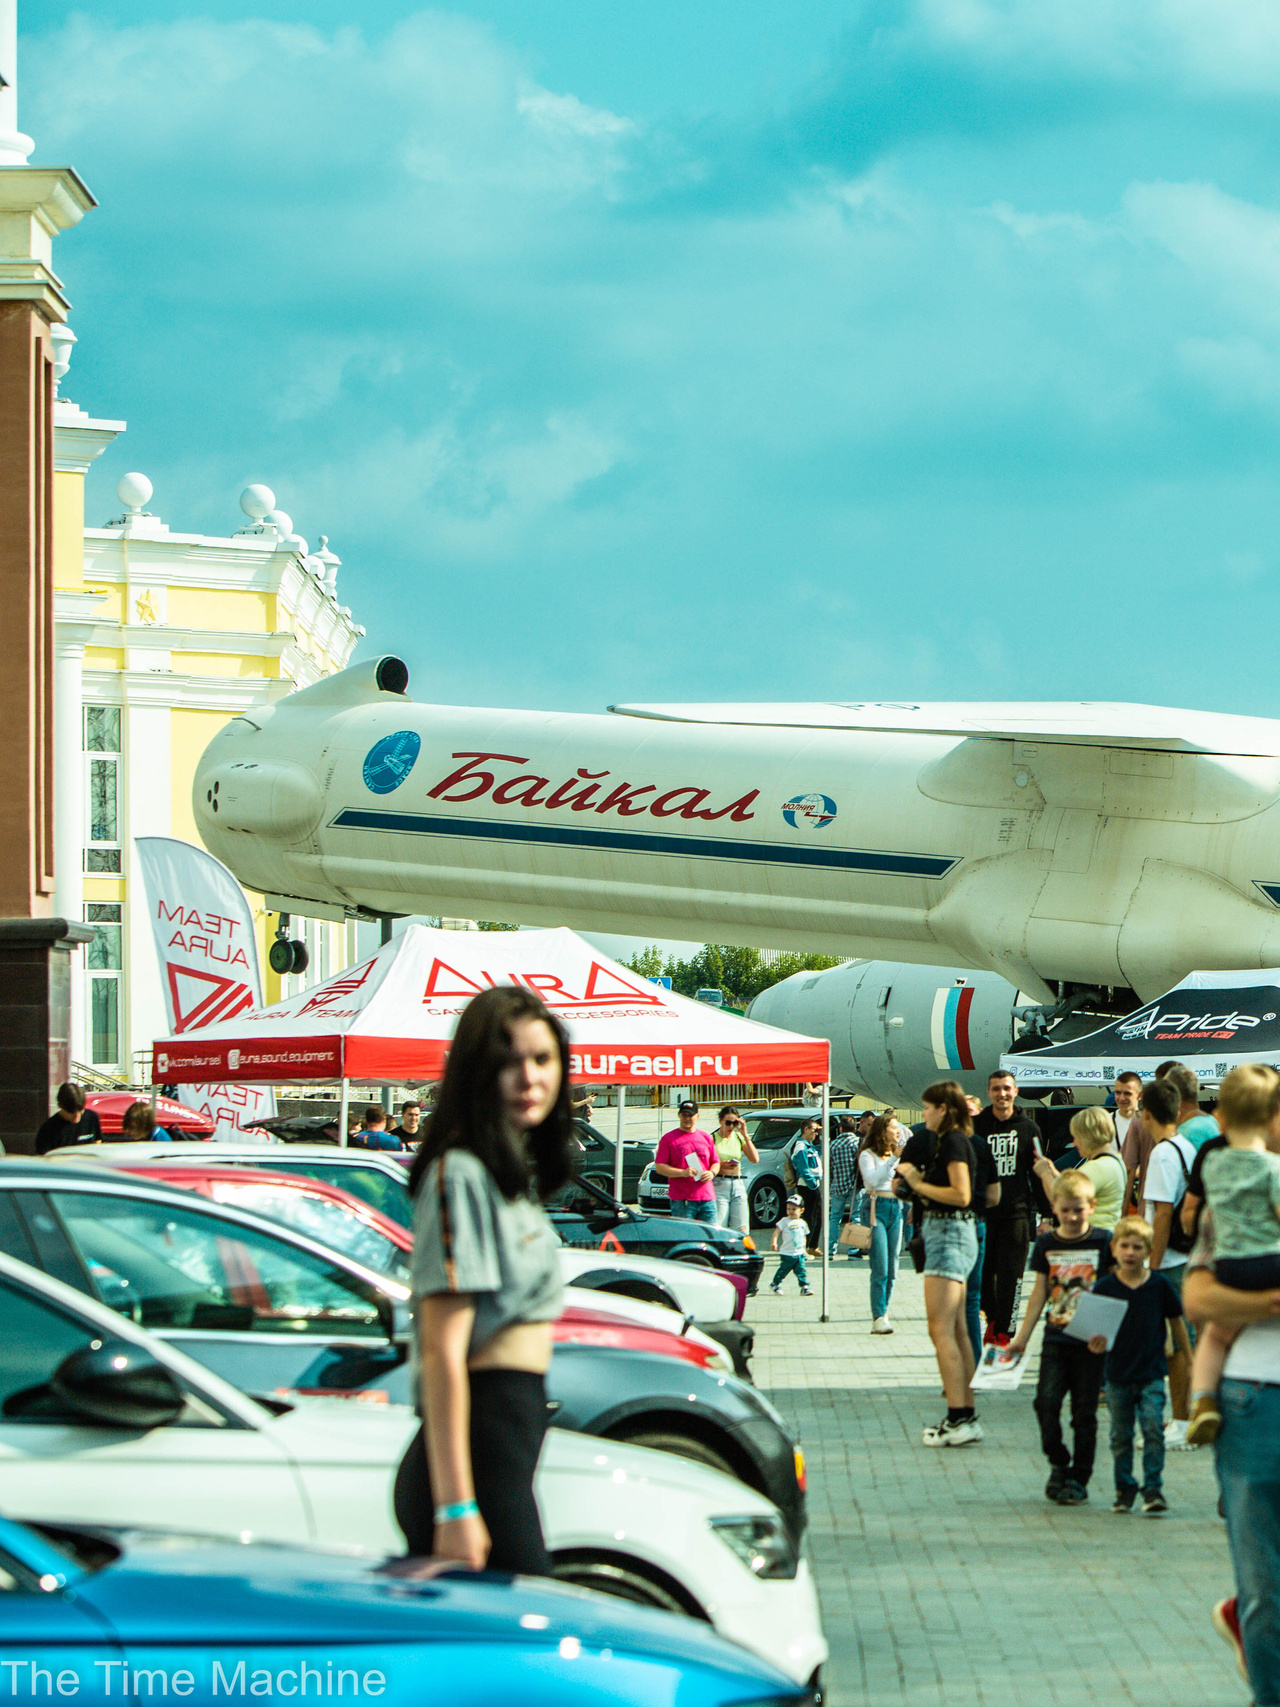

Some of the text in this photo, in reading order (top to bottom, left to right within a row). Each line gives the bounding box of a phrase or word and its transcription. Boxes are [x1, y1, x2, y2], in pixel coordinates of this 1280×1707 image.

[426, 752, 761, 822] Байкал
[781, 803, 816, 812] МОЛНИЯ
[554, 1009, 679, 1020] ACCESSORIES
[1154, 1032, 1182, 1040] TEAM
[1182, 1031, 1212, 1039] PRIDE
